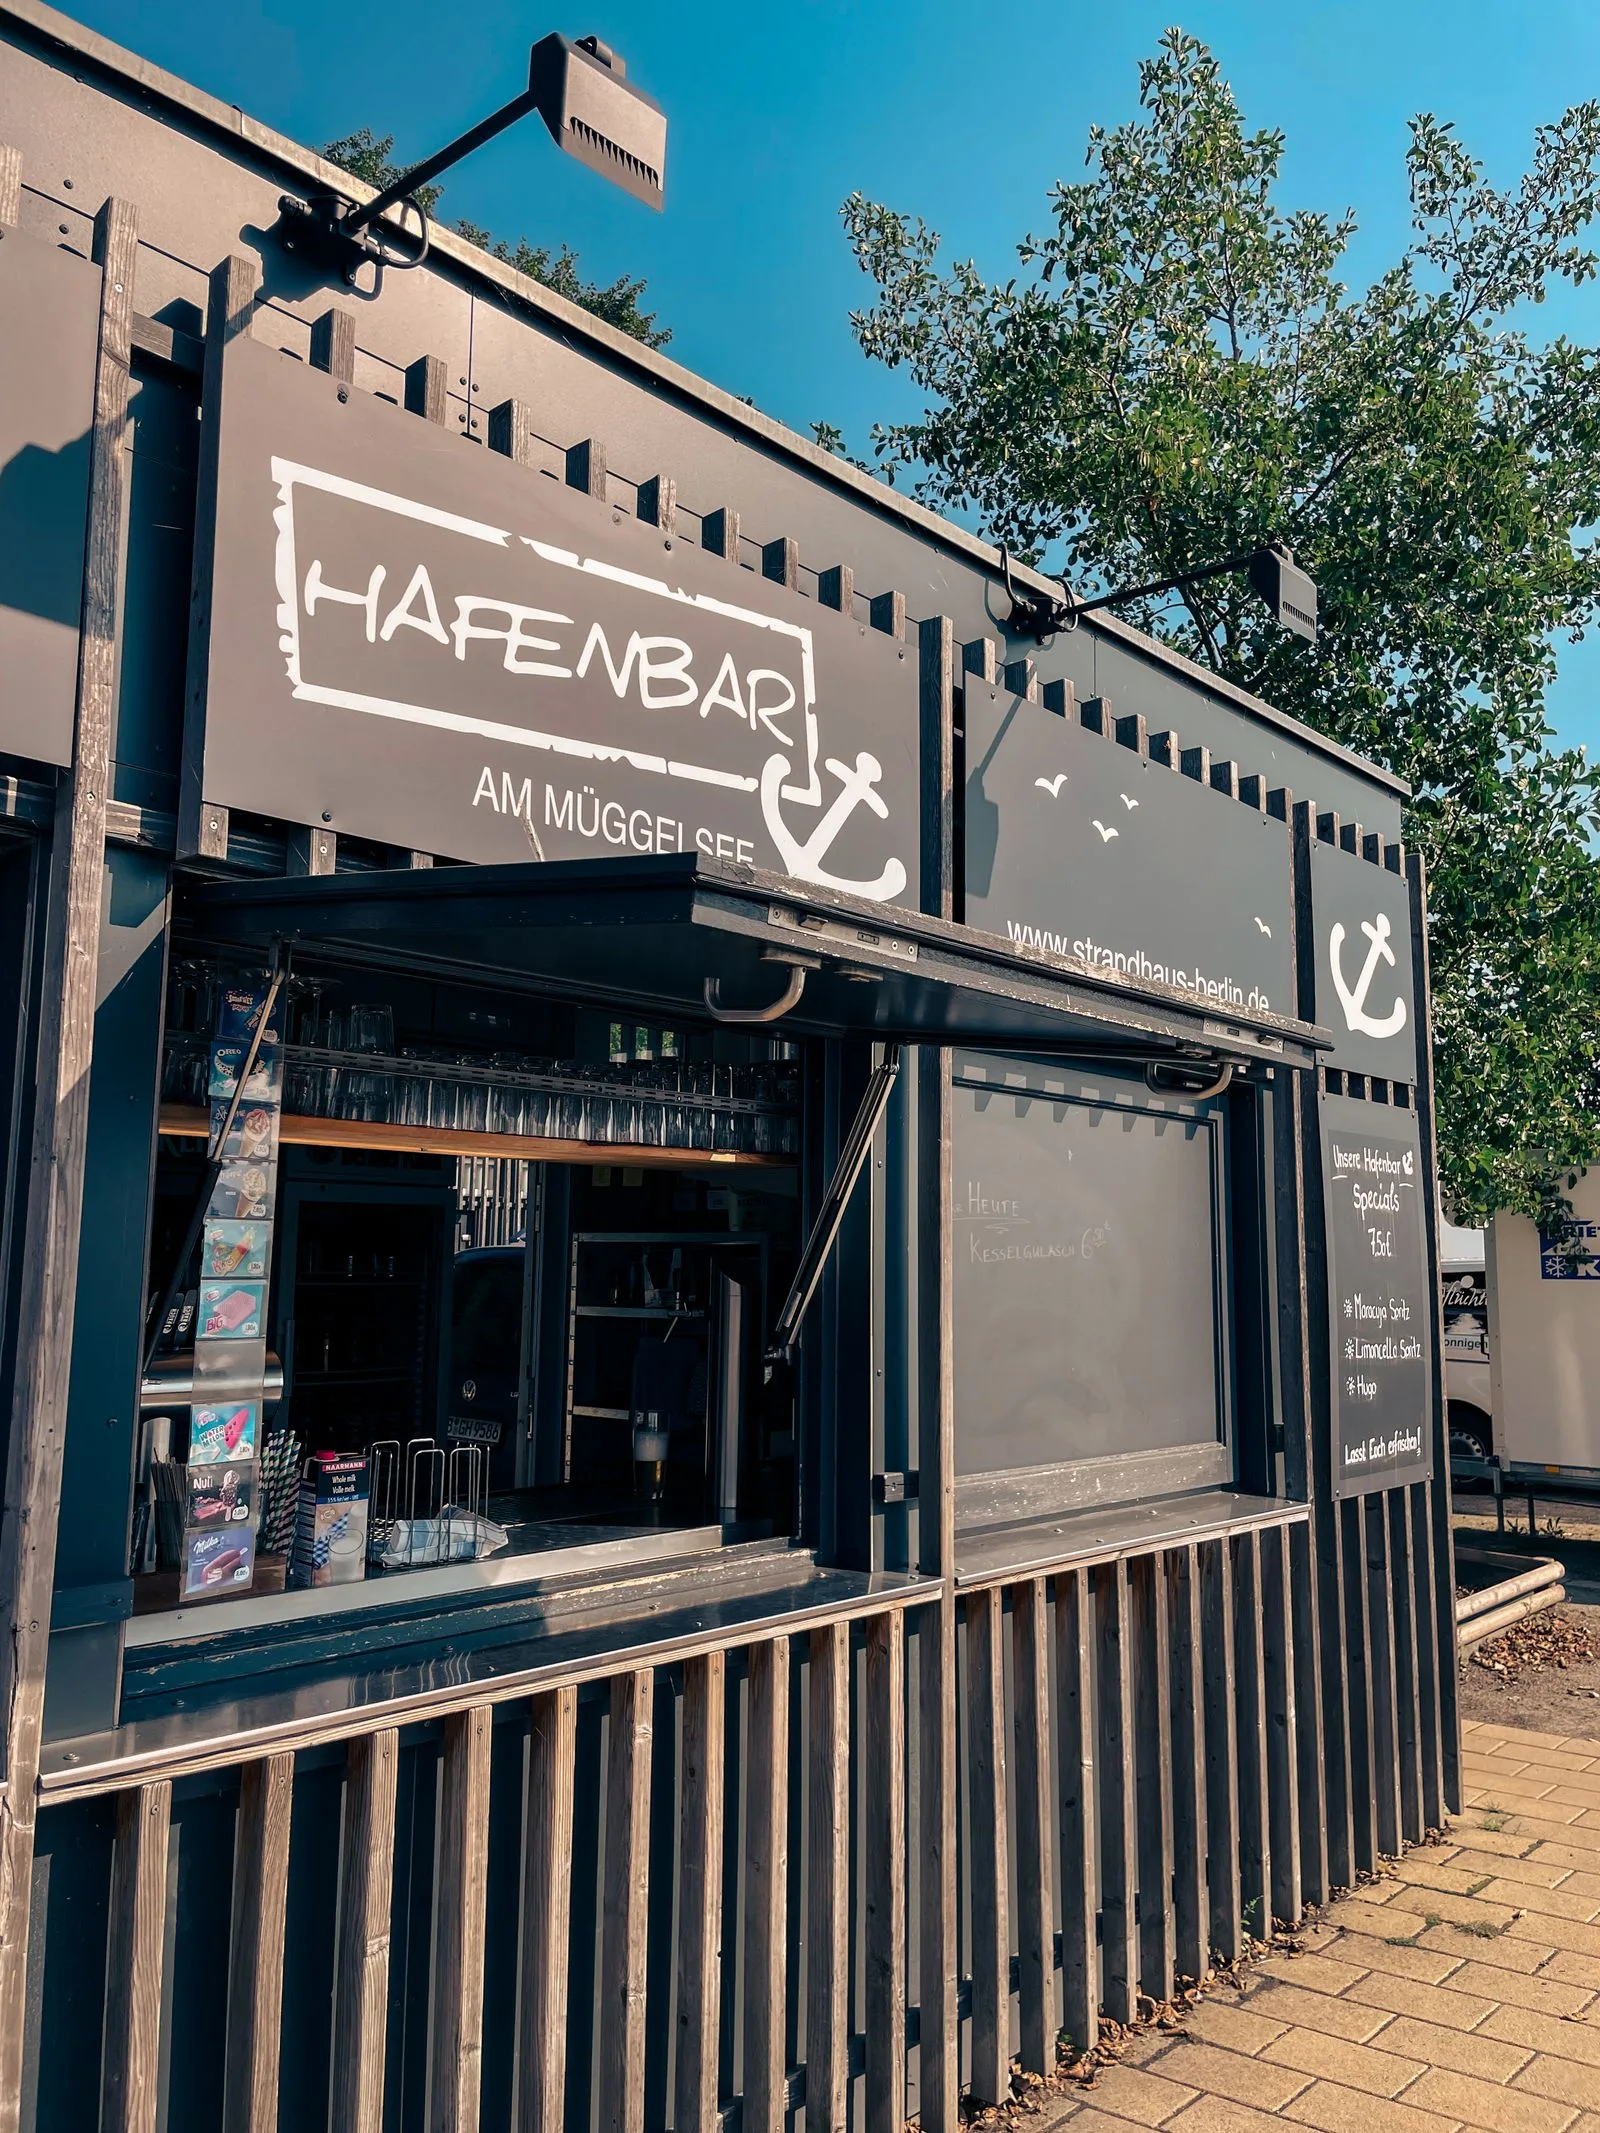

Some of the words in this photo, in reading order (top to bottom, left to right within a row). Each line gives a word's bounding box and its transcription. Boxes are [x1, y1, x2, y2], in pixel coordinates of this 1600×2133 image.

[304, 559, 796, 746] HAFENBAR
[472, 766, 532, 820] AM
[1007, 920, 1269, 1011] wwwstrandhaus-berlinde
[1333, 1144, 1360, 1169] Unsere
[1363, 1147, 1400, 1179] Hafenbar
[1353, 1181, 1400, 1221] Specials
[207, 1316, 223, 1330] BIG
[1354, 1293, 1387, 1328] Maracuja
[1355, 1336, 1397, 1359] Limoncello
[1357, 1374, 1377, 1400] Hugo
[200, 1425, 224, 1441] WATER
[1345, 1440, 1366, 1465] Lasst
[1369, 1436, 1386, 1460] Euch
[326, 1461, 363, 1471] NAARMANN
[332, 1475, 347, 1484] Whole
[193, 1536, 219, 1554] Milka
